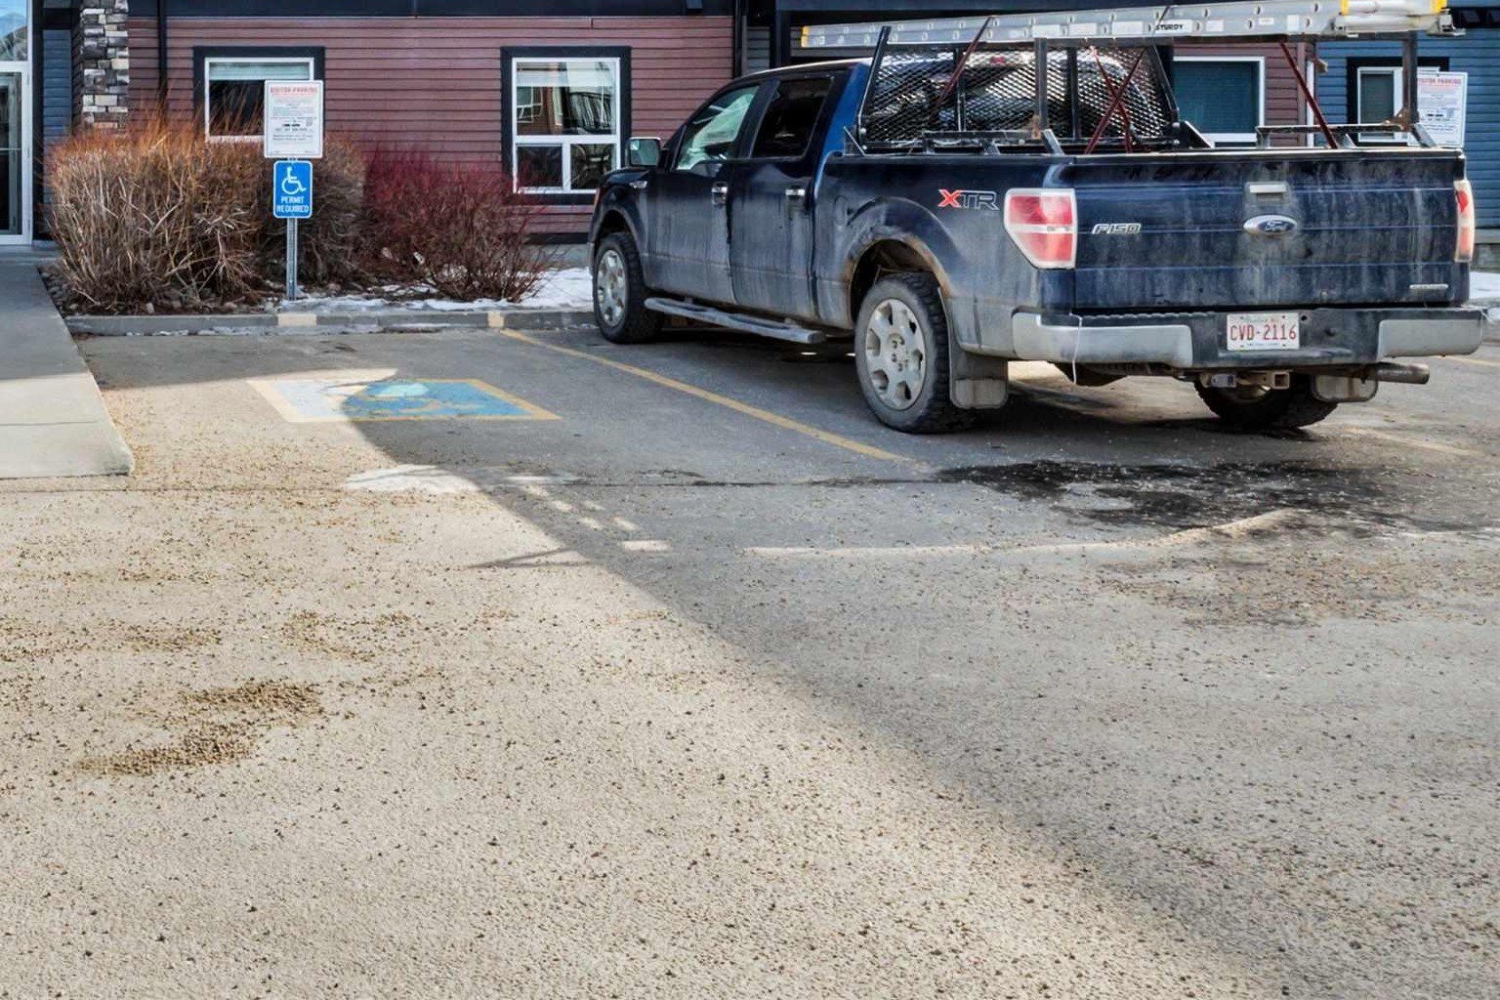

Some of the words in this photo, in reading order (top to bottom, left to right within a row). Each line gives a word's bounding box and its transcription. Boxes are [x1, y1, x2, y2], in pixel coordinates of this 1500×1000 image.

[281, 195, 304, 204] PERMIT
[937, 189, 999, 211] XTR
[276, 204, 309, 213] REQUIRED
[1230, 323, 1297, 341] CVD-2116
